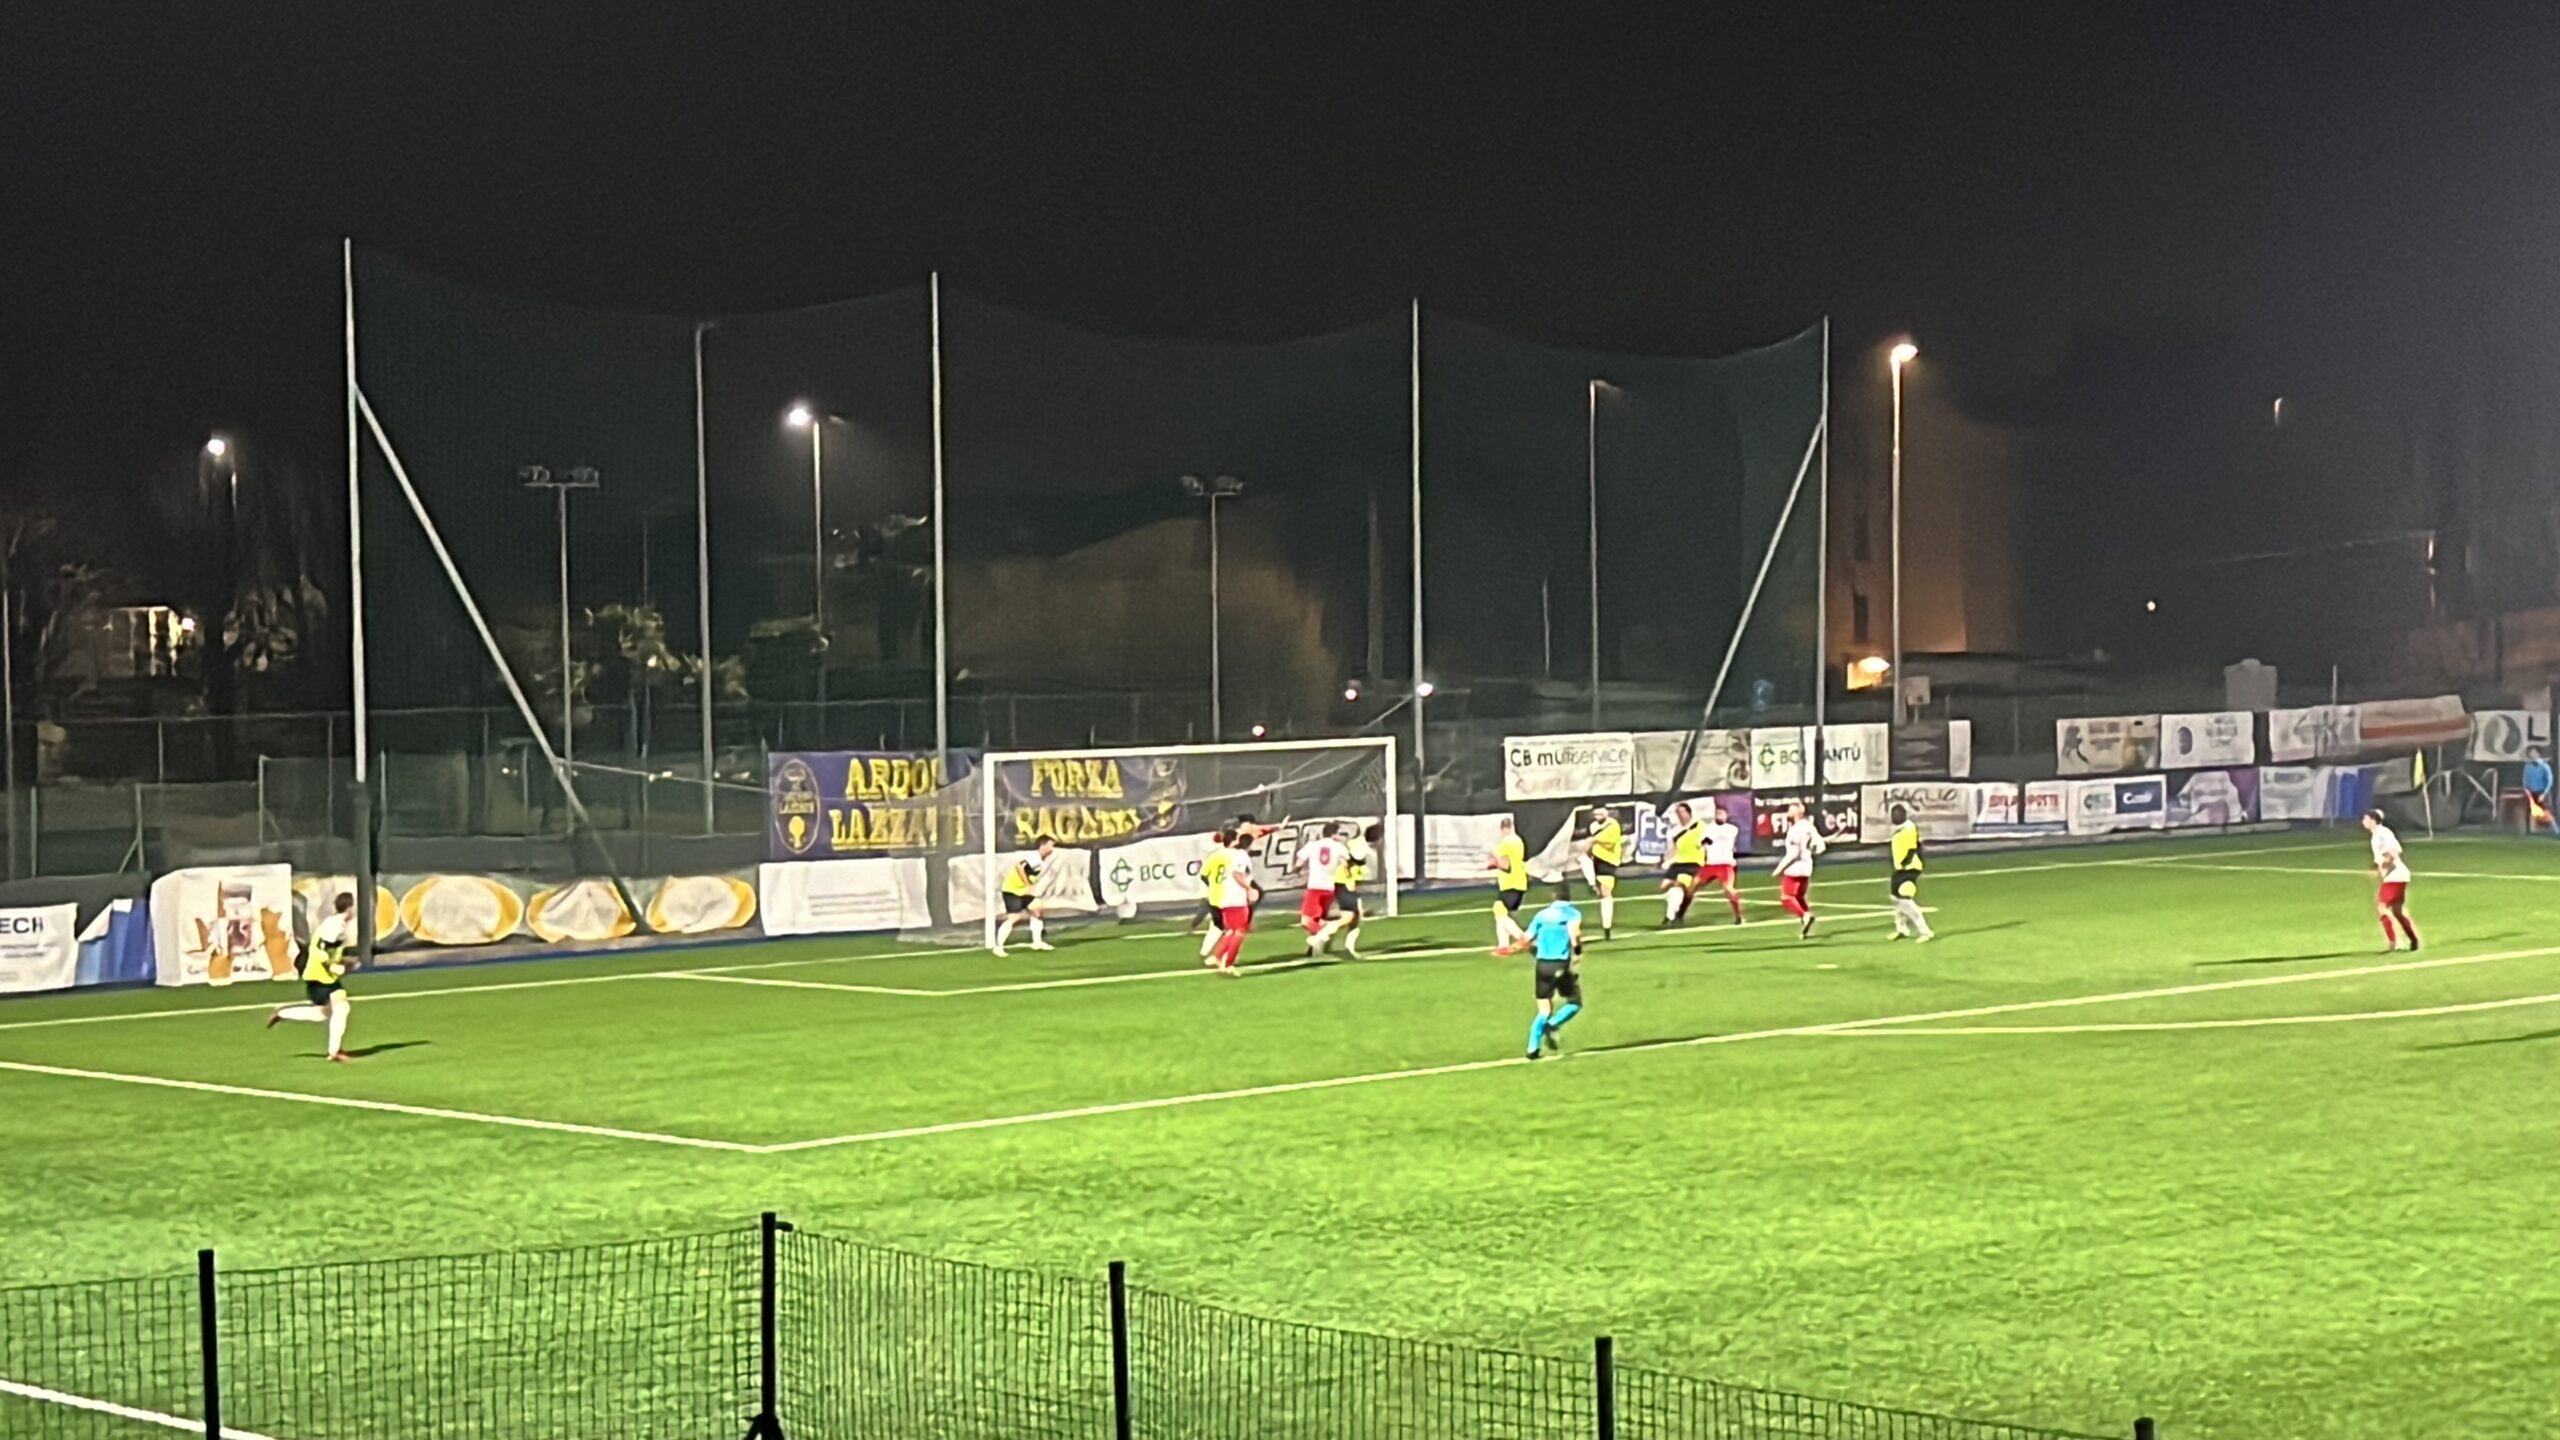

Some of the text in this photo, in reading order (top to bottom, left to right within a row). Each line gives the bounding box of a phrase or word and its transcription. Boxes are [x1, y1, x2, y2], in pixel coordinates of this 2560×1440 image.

[1510, 748, 1532, 768] CB
[1031, 759, 1125, 799] FORZA
[1140, 862, 1176, 882] BCC
